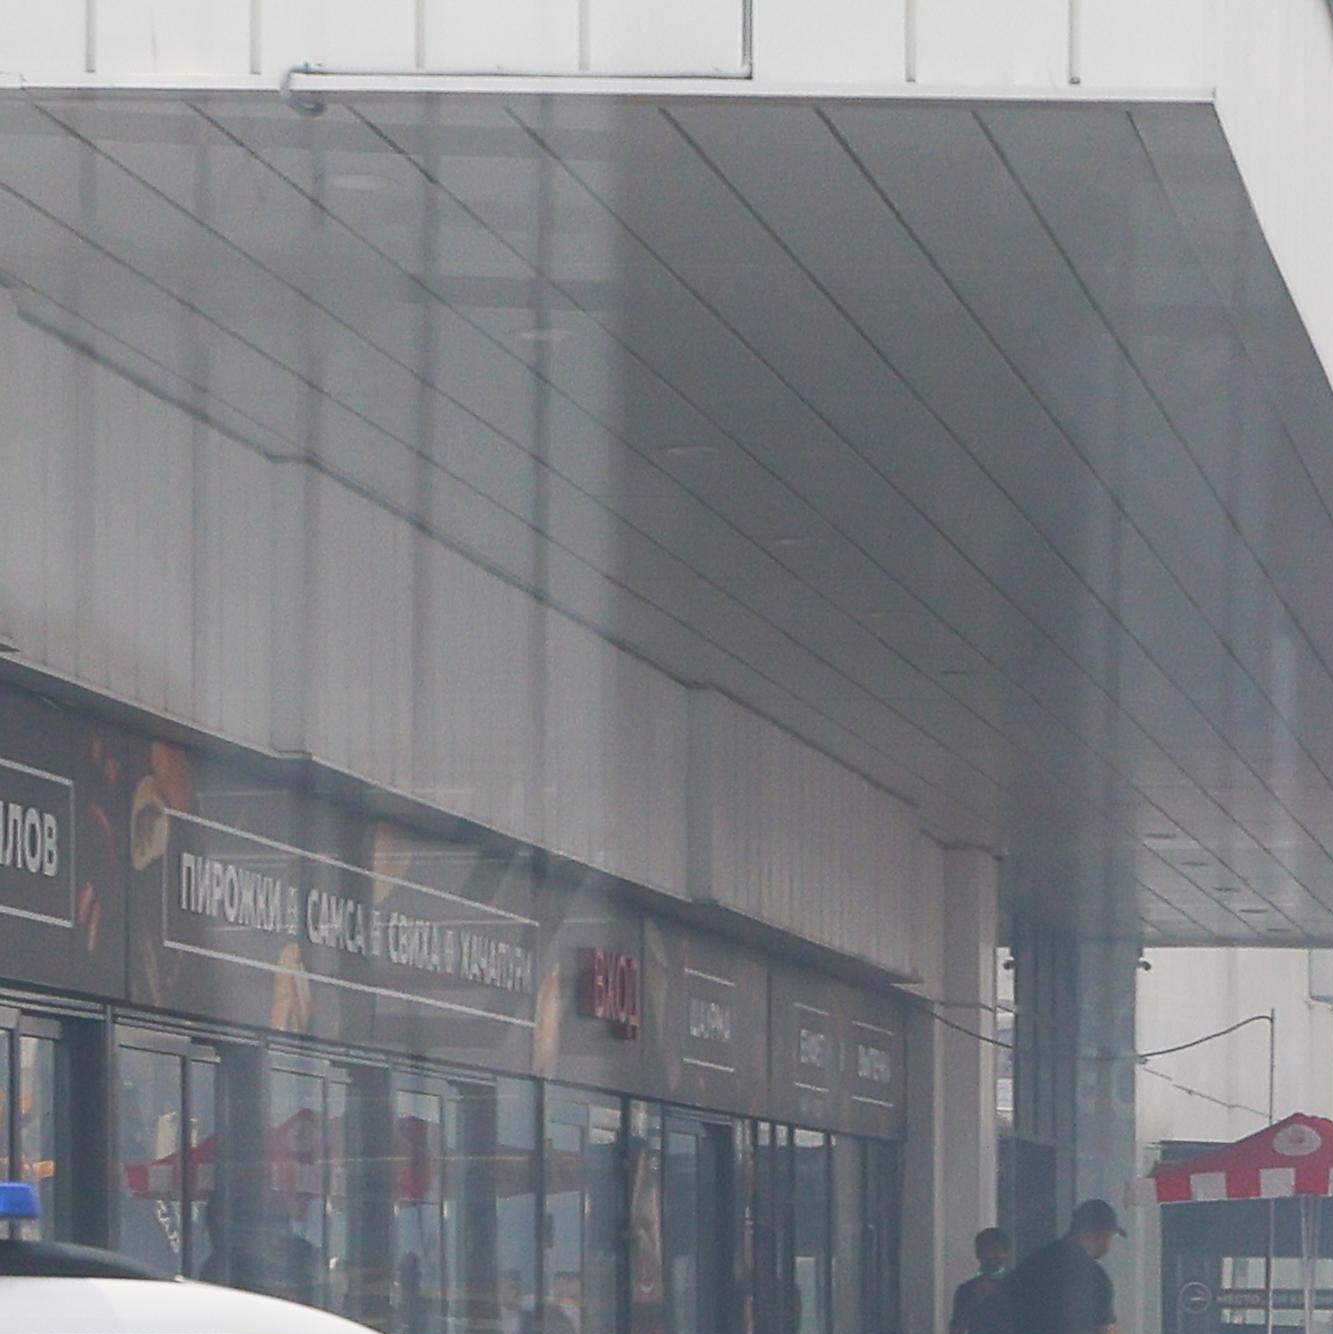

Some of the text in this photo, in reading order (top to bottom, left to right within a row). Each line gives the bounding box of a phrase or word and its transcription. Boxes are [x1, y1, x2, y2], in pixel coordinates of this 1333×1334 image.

[0, 803, 57, 876] ЛОВ
[180, 852, 281, 932] ПИРОЖКИ
[306, 888, 366, 956] САМСА
[594, 948, 639, 1040] ВХОД
